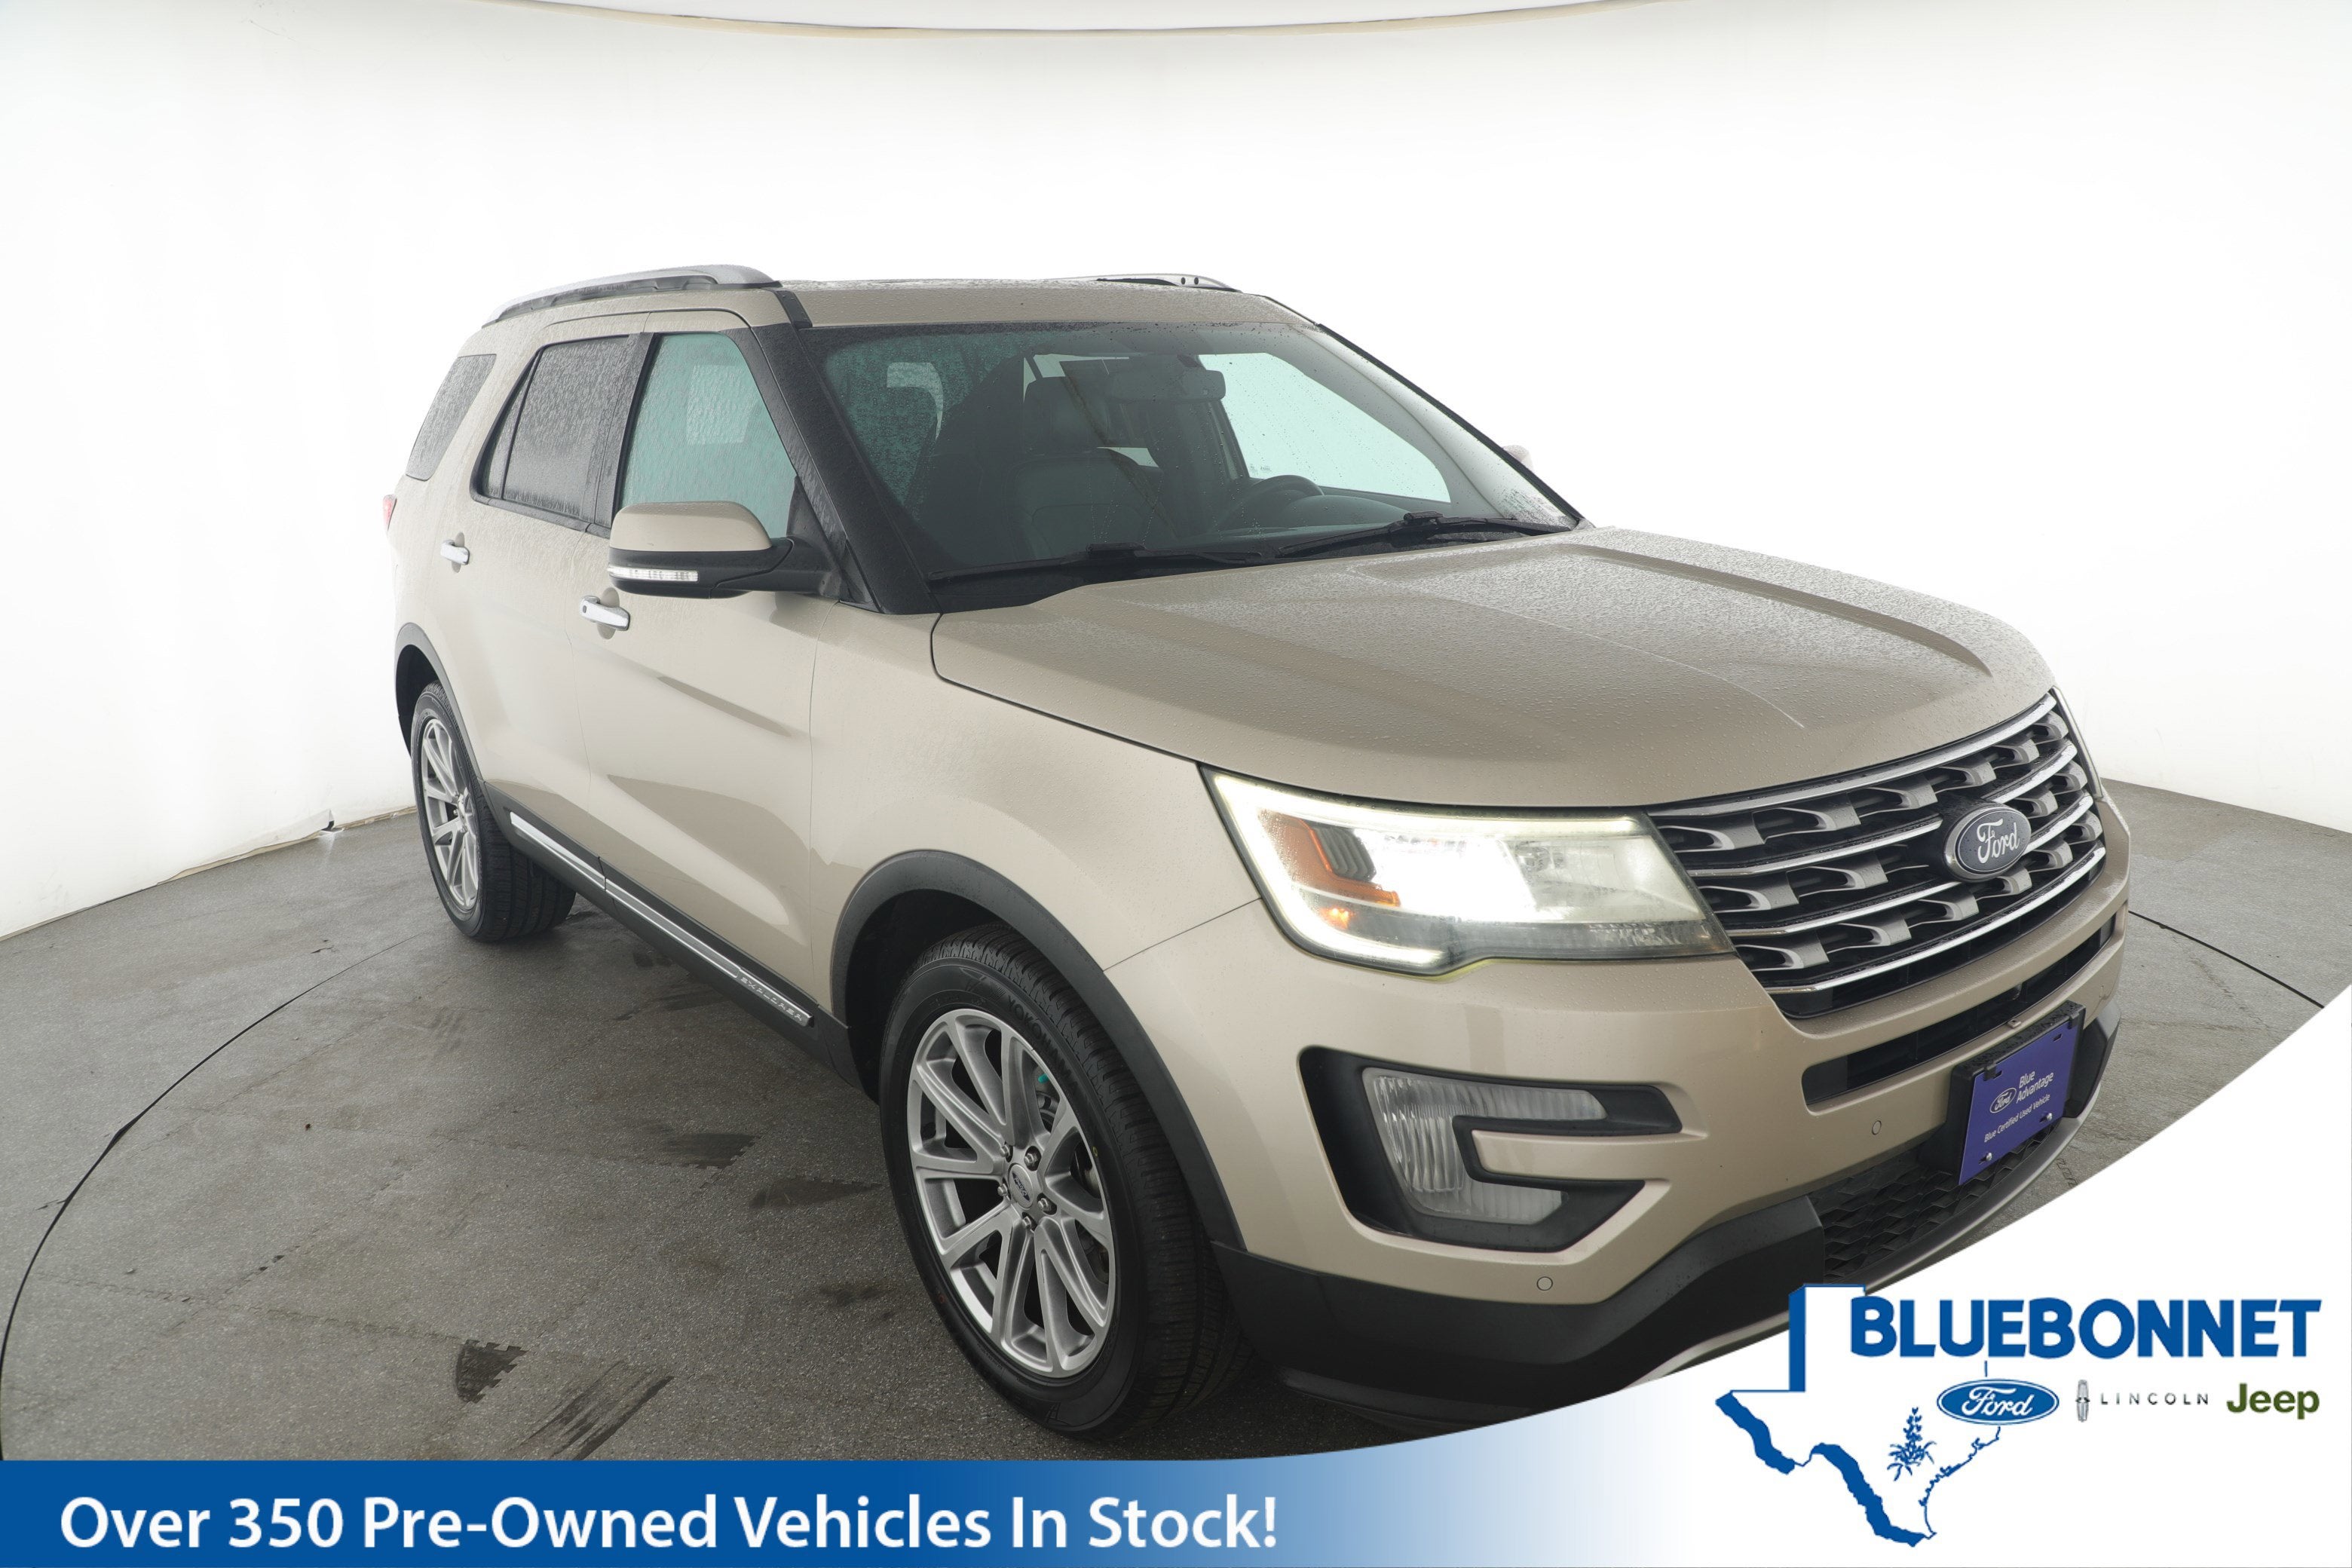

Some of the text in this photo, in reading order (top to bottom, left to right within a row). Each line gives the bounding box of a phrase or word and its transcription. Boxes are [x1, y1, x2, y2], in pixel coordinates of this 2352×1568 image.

[1977, 818, 2020, 864] Ford
[1007, 994, 1079, 1095] YOKOHAMA
[2015, 1072, 2054, 1104] Advantage
[2018, 1070, 2035, 1089] Blue
[1983, 1093, 2050, 1143] Blue Certified Used Vehicle
[1994, 1092, 2013, 1111] Ford
